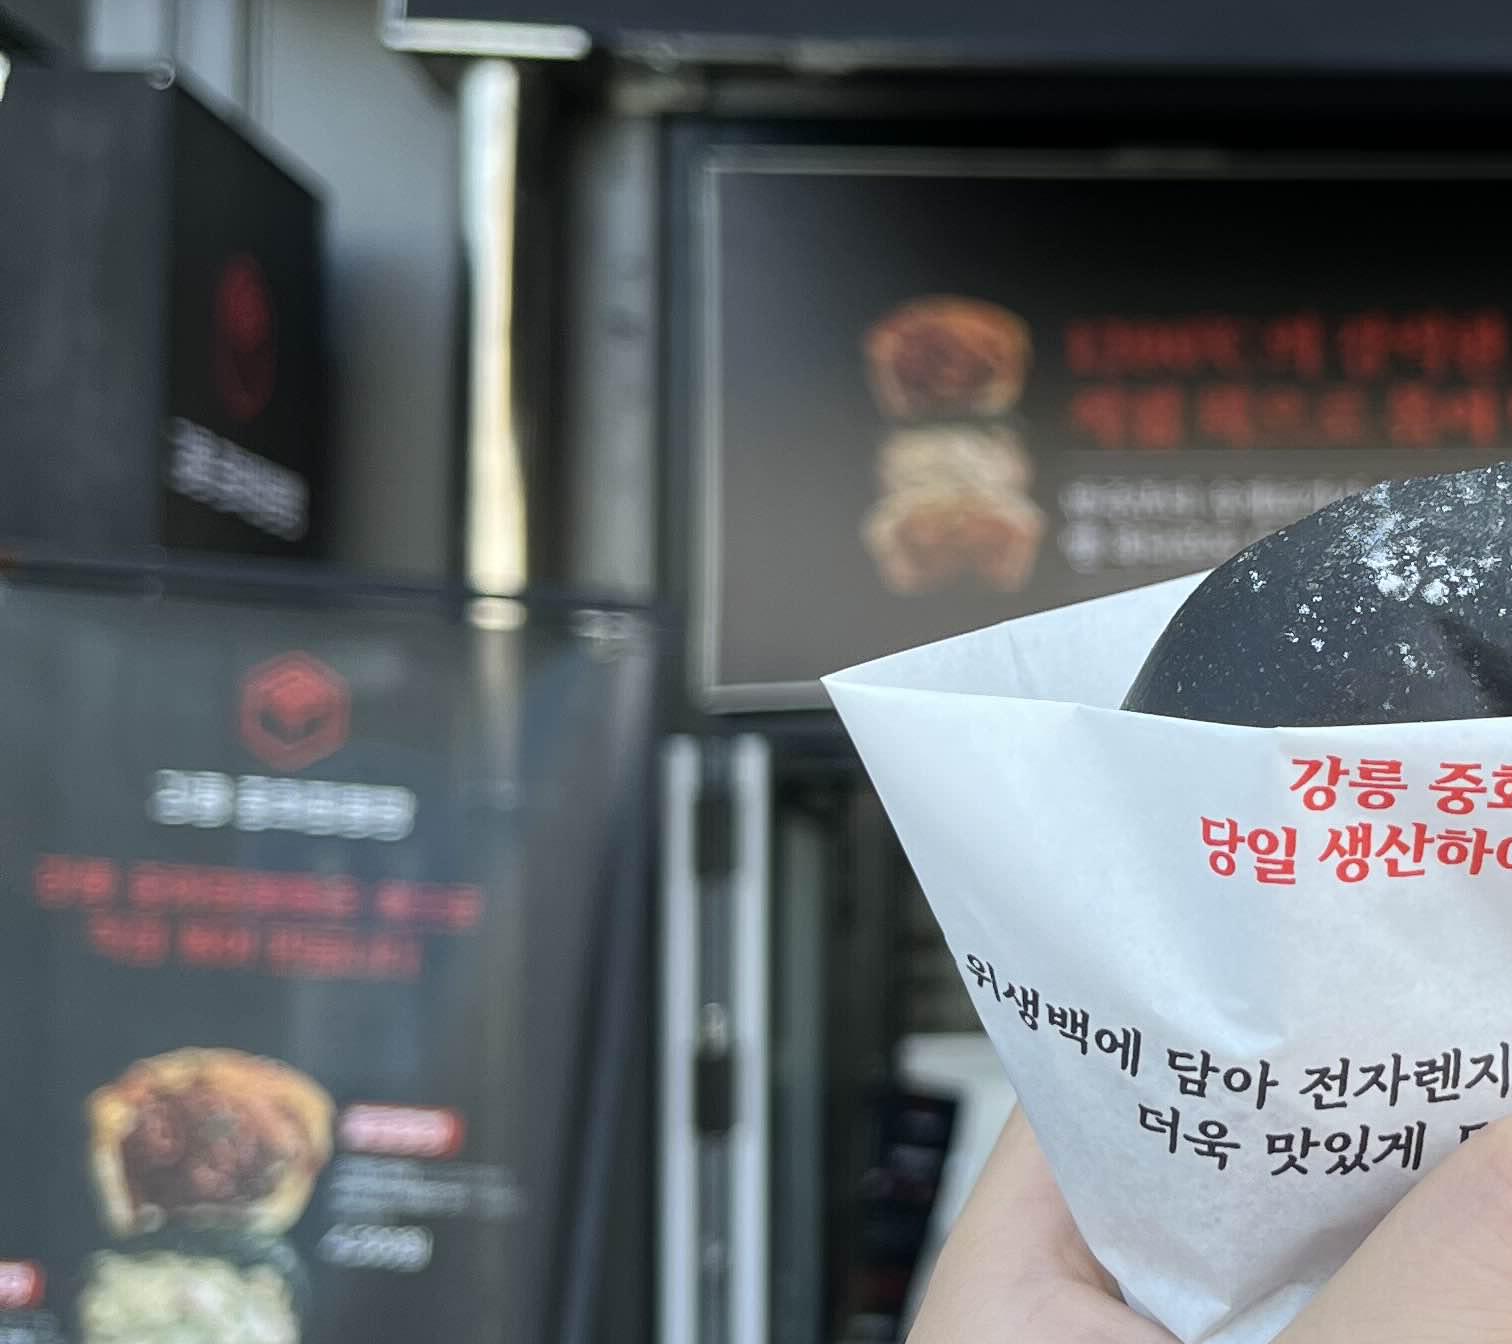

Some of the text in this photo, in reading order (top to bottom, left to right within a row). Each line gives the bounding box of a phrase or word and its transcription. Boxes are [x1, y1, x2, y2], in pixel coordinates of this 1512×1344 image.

[1289, 755, 1410, 813] 강릉
[1201, 816, 1298, 887] 당일
[966, 952, 1143, 1078] 위생백에
[1166, 1047, 1280, 1111] 담아
[1137, 1102, 1242, 1171] 더욱
[1264, 1119, 1428, 1177] 맛있게
